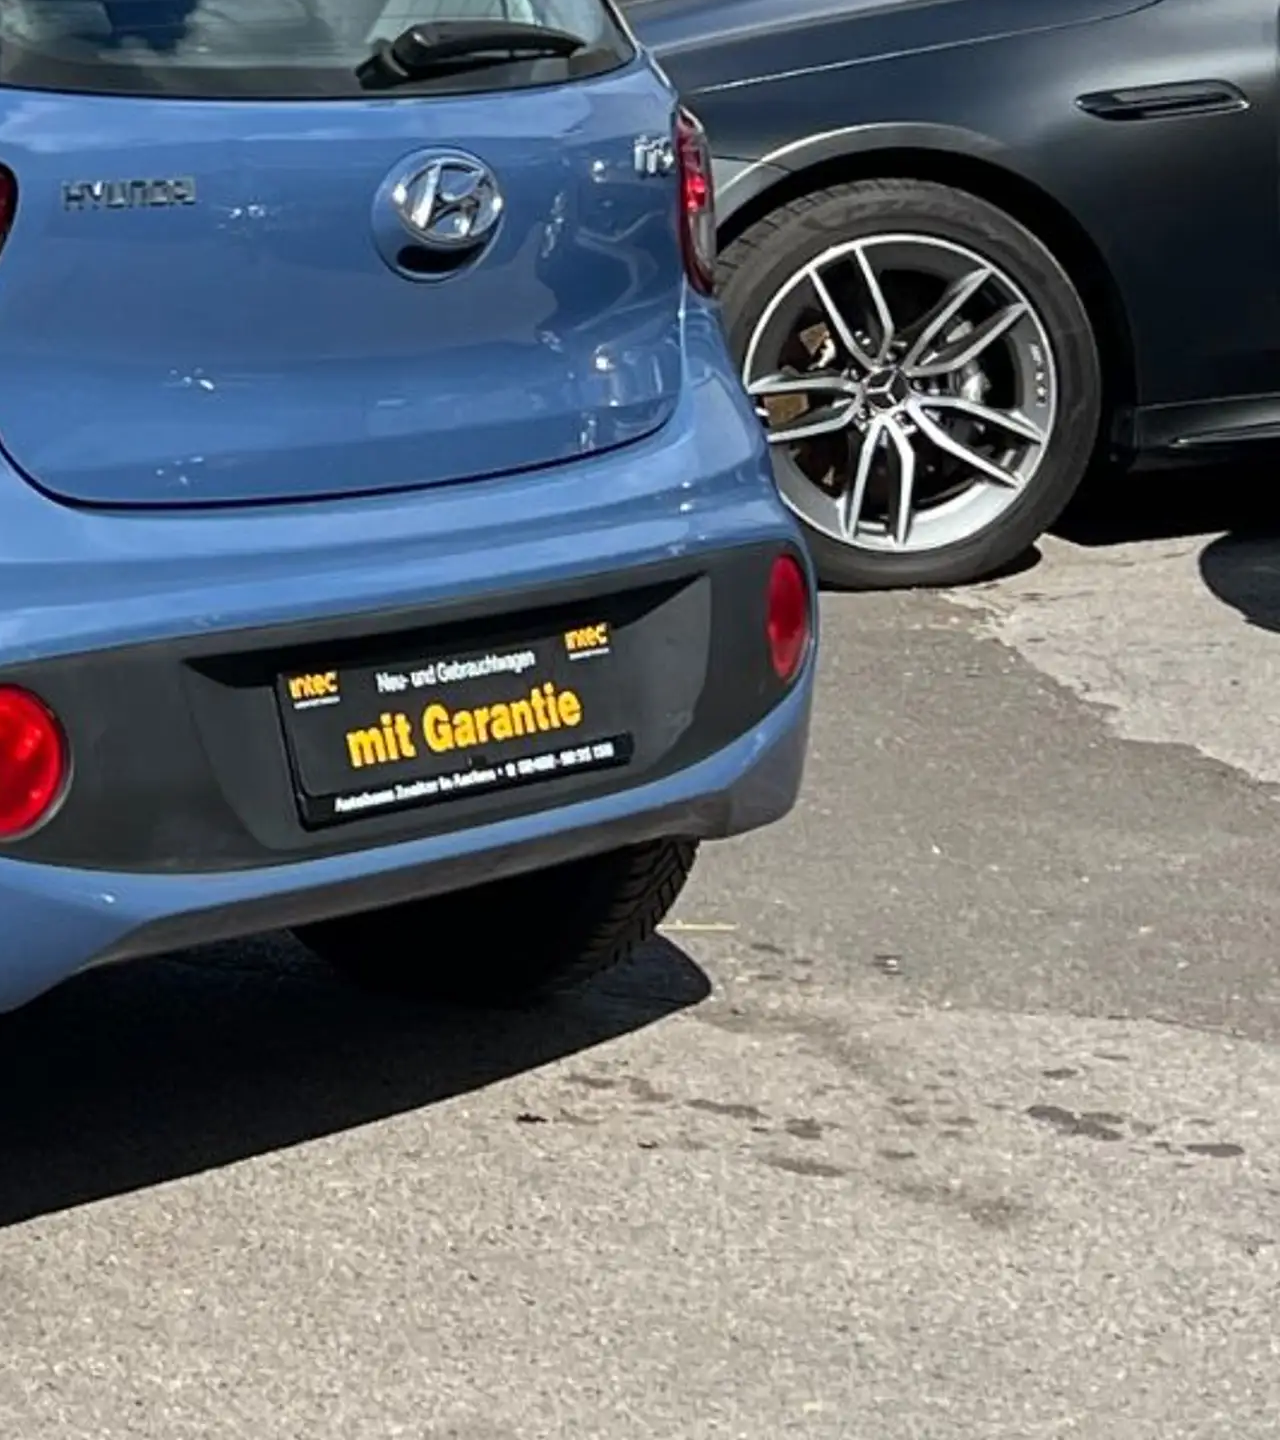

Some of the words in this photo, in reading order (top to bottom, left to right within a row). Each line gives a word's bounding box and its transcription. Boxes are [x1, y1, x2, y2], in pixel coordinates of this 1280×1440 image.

[61, 178, 196, 211] HYUNDAI
[346, 712, 416, 768] mit
[423, 683, 582, 752] Garantie
